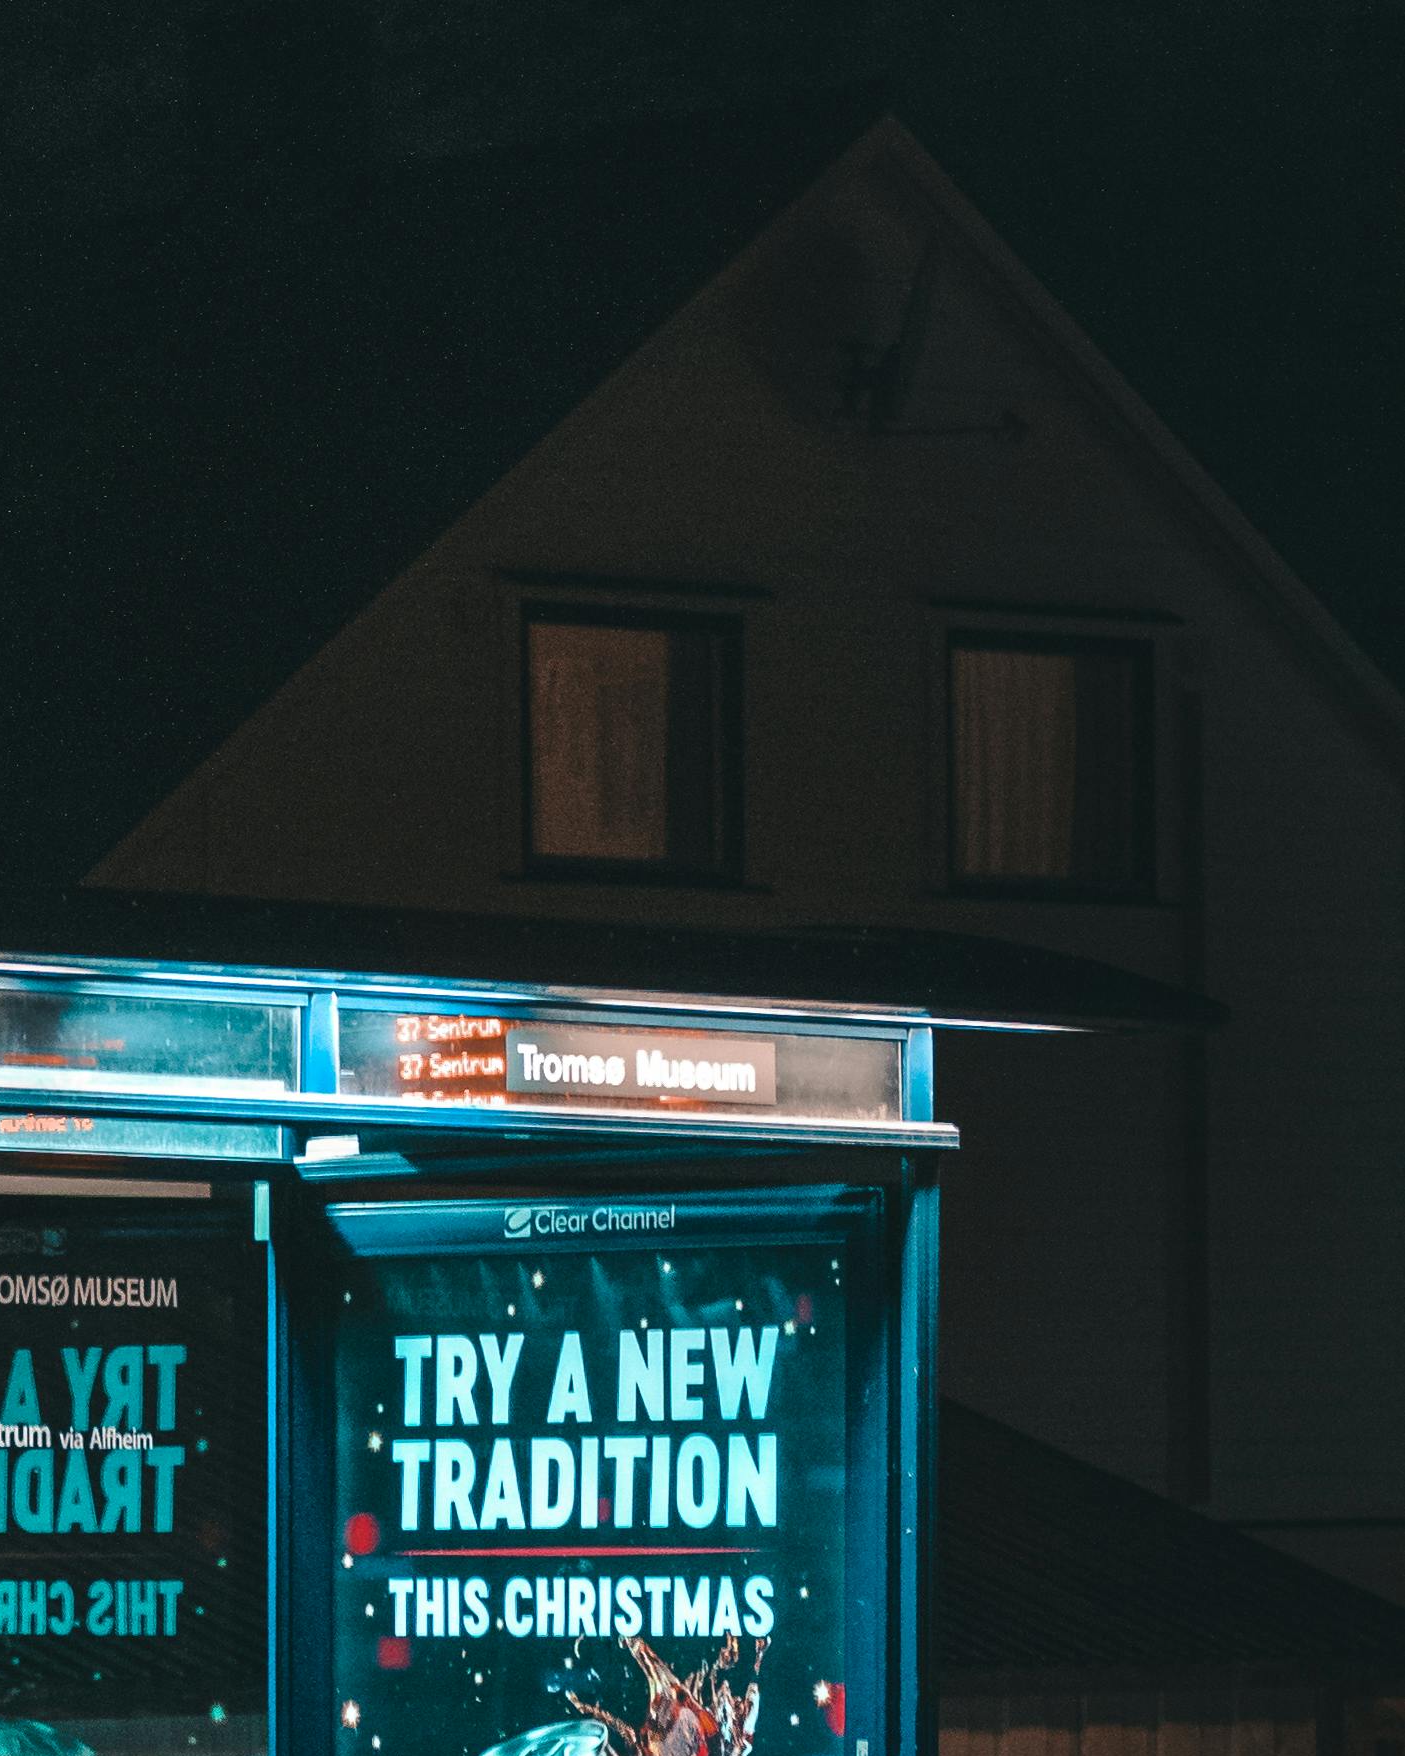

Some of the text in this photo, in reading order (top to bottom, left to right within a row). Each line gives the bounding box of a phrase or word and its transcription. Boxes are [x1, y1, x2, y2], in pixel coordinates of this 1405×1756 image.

[397, 1014, 501, 1041] 37 Sentrum
[400, 1051, 504, 1079] 37 Sentrum
[517, 1043, 757, 1092] Tromsø Museum
[535, 1203, 676, 1234] Clear Channel
[74, 1276, 177, 1308] MUSEUM
[395, 1326, 779, 1426] TRY A NEW
[59, 1427, 84, 1449] via
[89, 1426, 154, 1450] Alfheim
[392, 1433, 778, 1531] TRADITION
[388, 1573, 775, 1640] THIS CHRISTMAS
